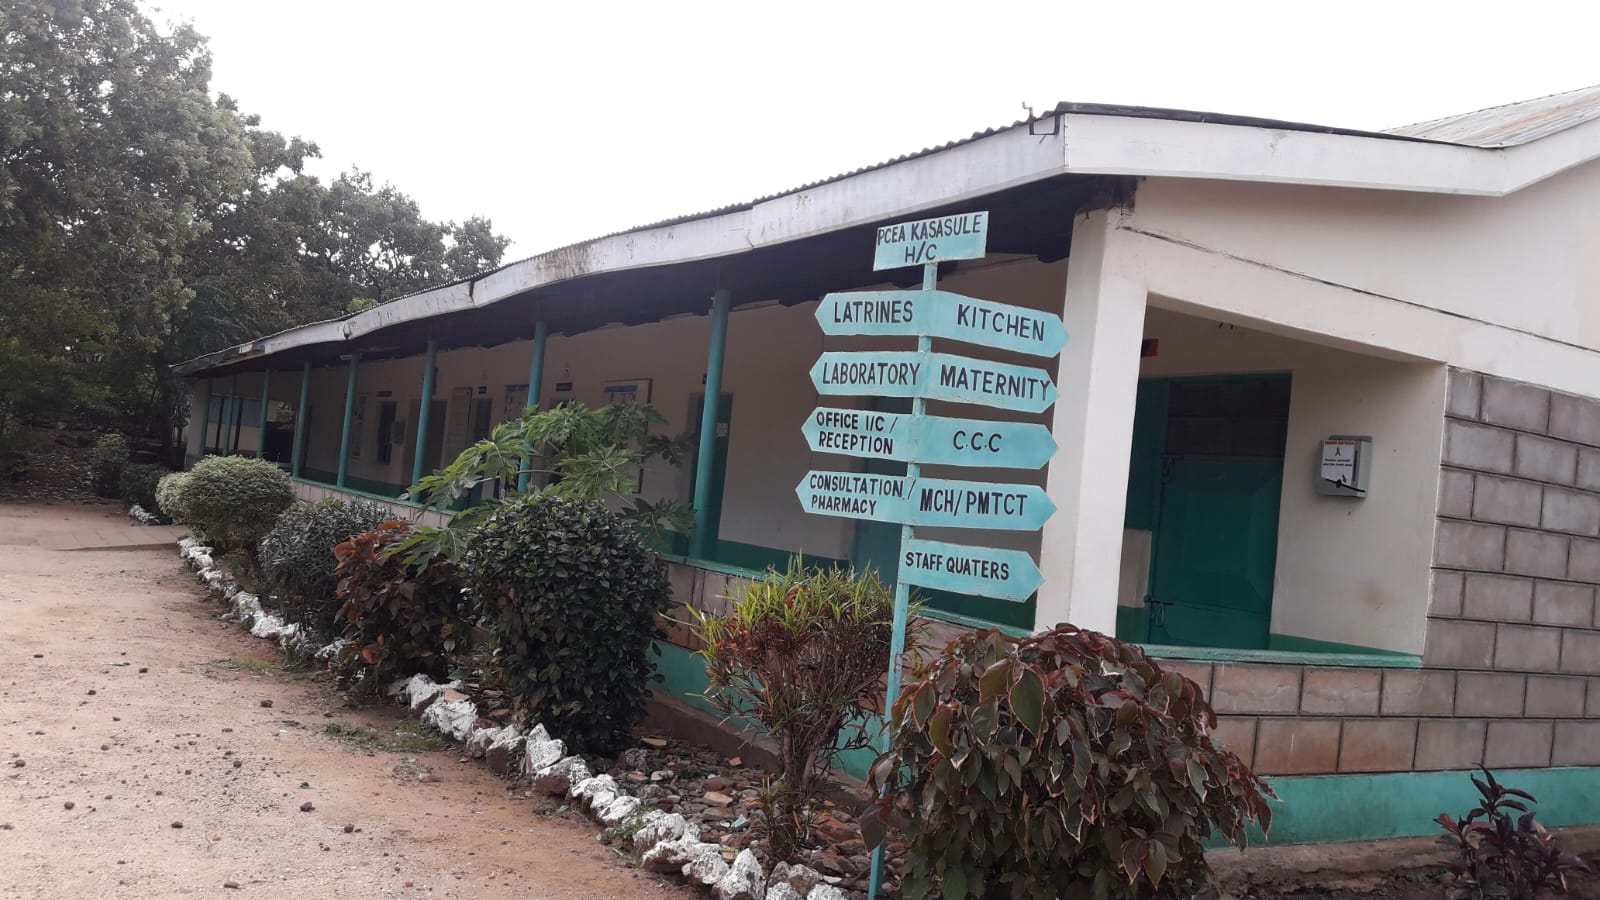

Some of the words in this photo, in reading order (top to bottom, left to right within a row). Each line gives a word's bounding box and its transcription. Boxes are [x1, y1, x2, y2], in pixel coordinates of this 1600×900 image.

[877, 226, 905, 246] PCEA
[911, 214, 982, 239] KASASULE
[904, 241, 937, 263] H/C
[834, 301, 913, 323] LATRINES
[957, 304, 1045, 341] KITCHEN
[822, 362, 920, 385] LABORATORY
[940, 365, 1051, 402] MATERNITY
[816, 411, 859, 430] OFFICE
[818, 431, 894, 455] RECEPTION
[953, 431, 1002, 453] C.C.C
[811, 495, 877, 516] PHARMACY
[905, 552, 943, 572] STAFF
[946, 557, 1009, 580] QUATERS
